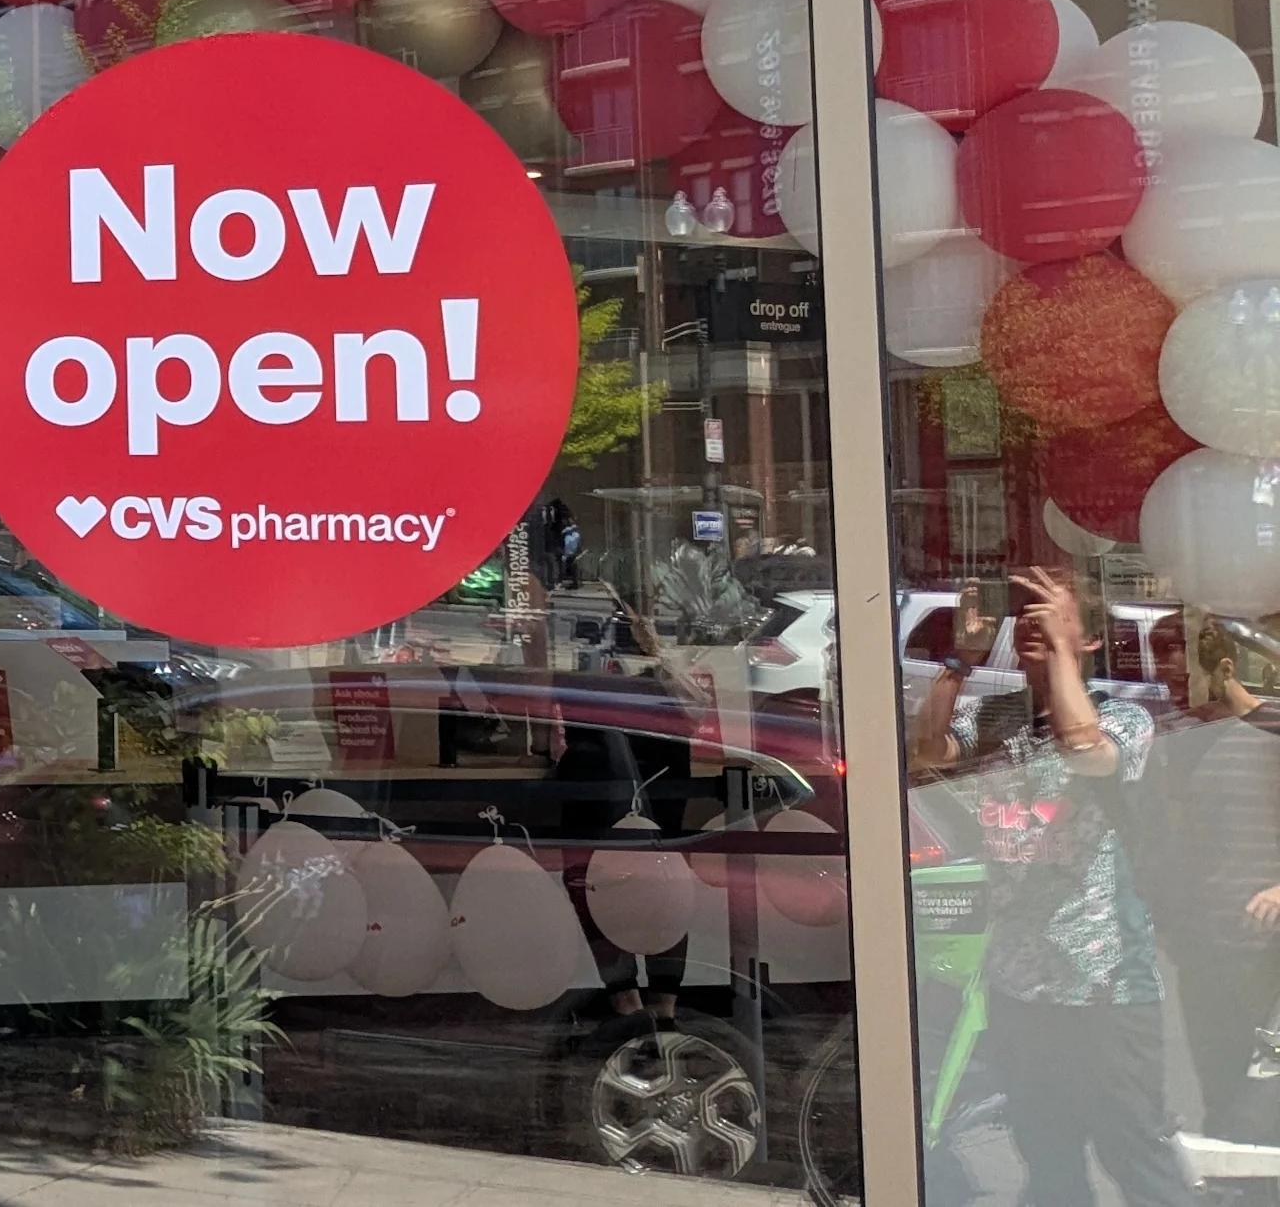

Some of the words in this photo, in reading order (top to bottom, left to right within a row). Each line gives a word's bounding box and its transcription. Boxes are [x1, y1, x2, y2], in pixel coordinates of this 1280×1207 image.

[69, 164, 437, 283] Now
[750, 299, 785, 320] drop
[789, 302, 809, 318] off
[24, 297, 482, 456] open!
[109, 495, 222, 542] CVS
[338, 713, 378, 723] products
